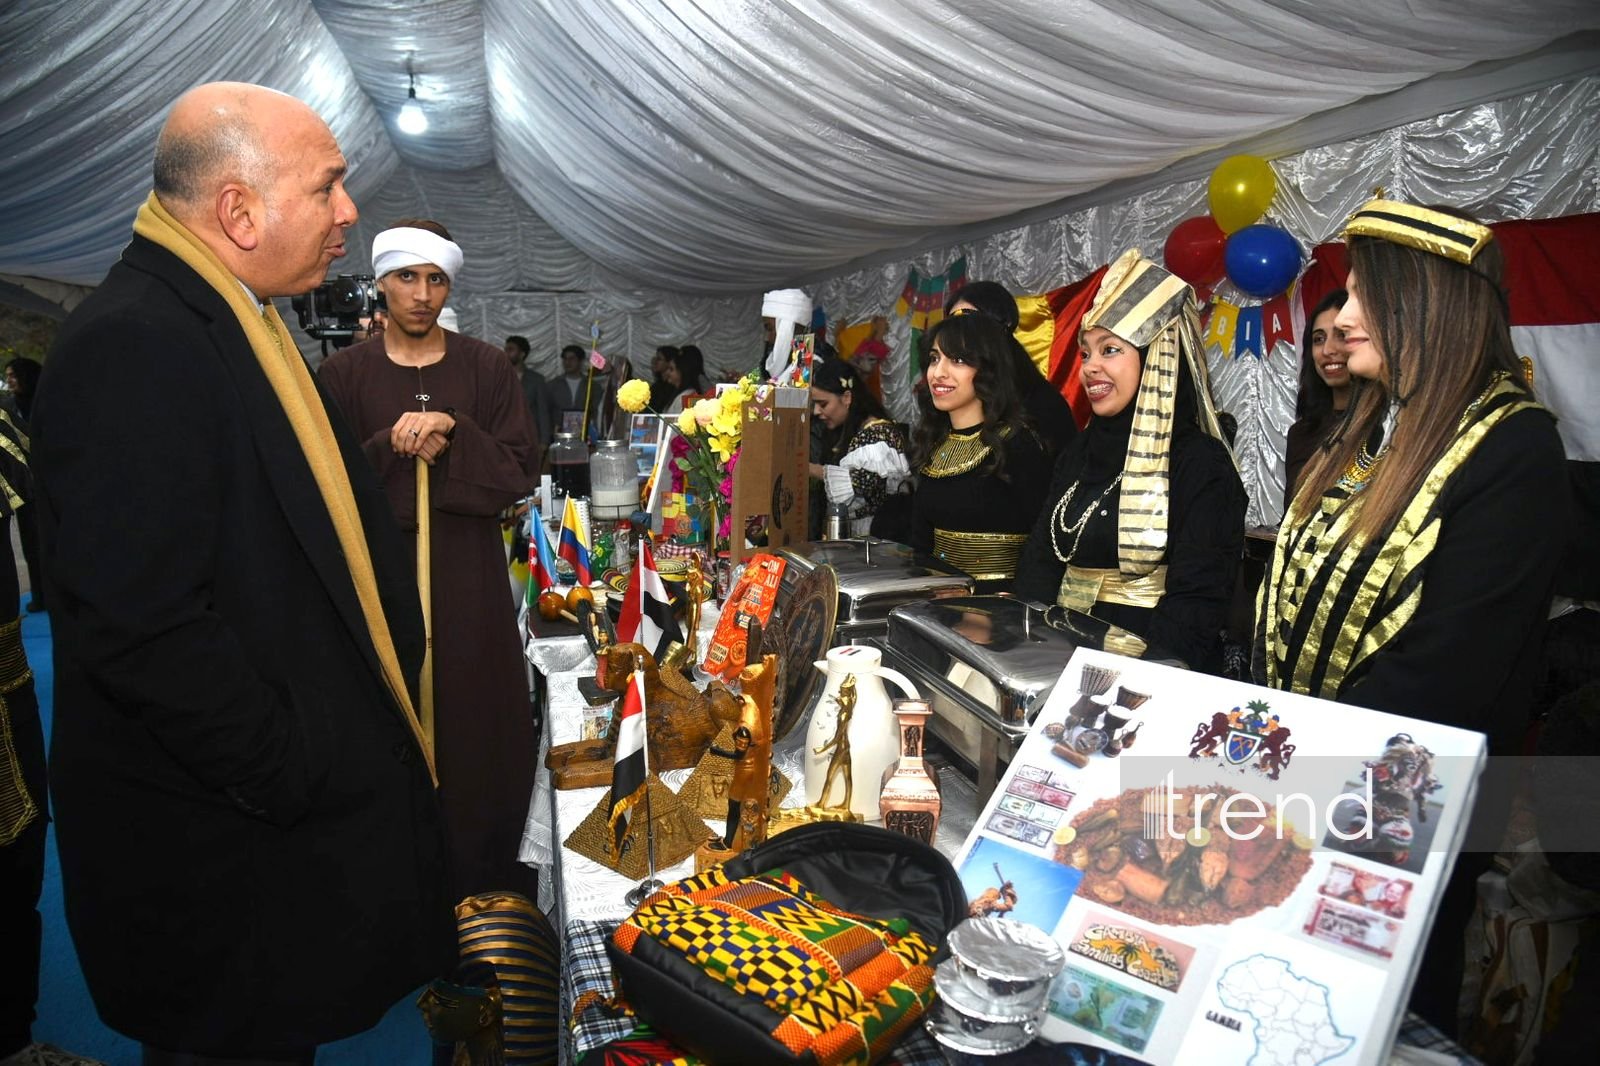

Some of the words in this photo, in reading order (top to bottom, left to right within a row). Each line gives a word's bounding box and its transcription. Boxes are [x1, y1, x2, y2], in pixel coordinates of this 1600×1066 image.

[767, 559, 780, 573] OM
[764, 574, 779, 589] ALI
[1083, 924, 1151, 953] GAMBIA
[1077, 938, 1125, 969] Smiling
